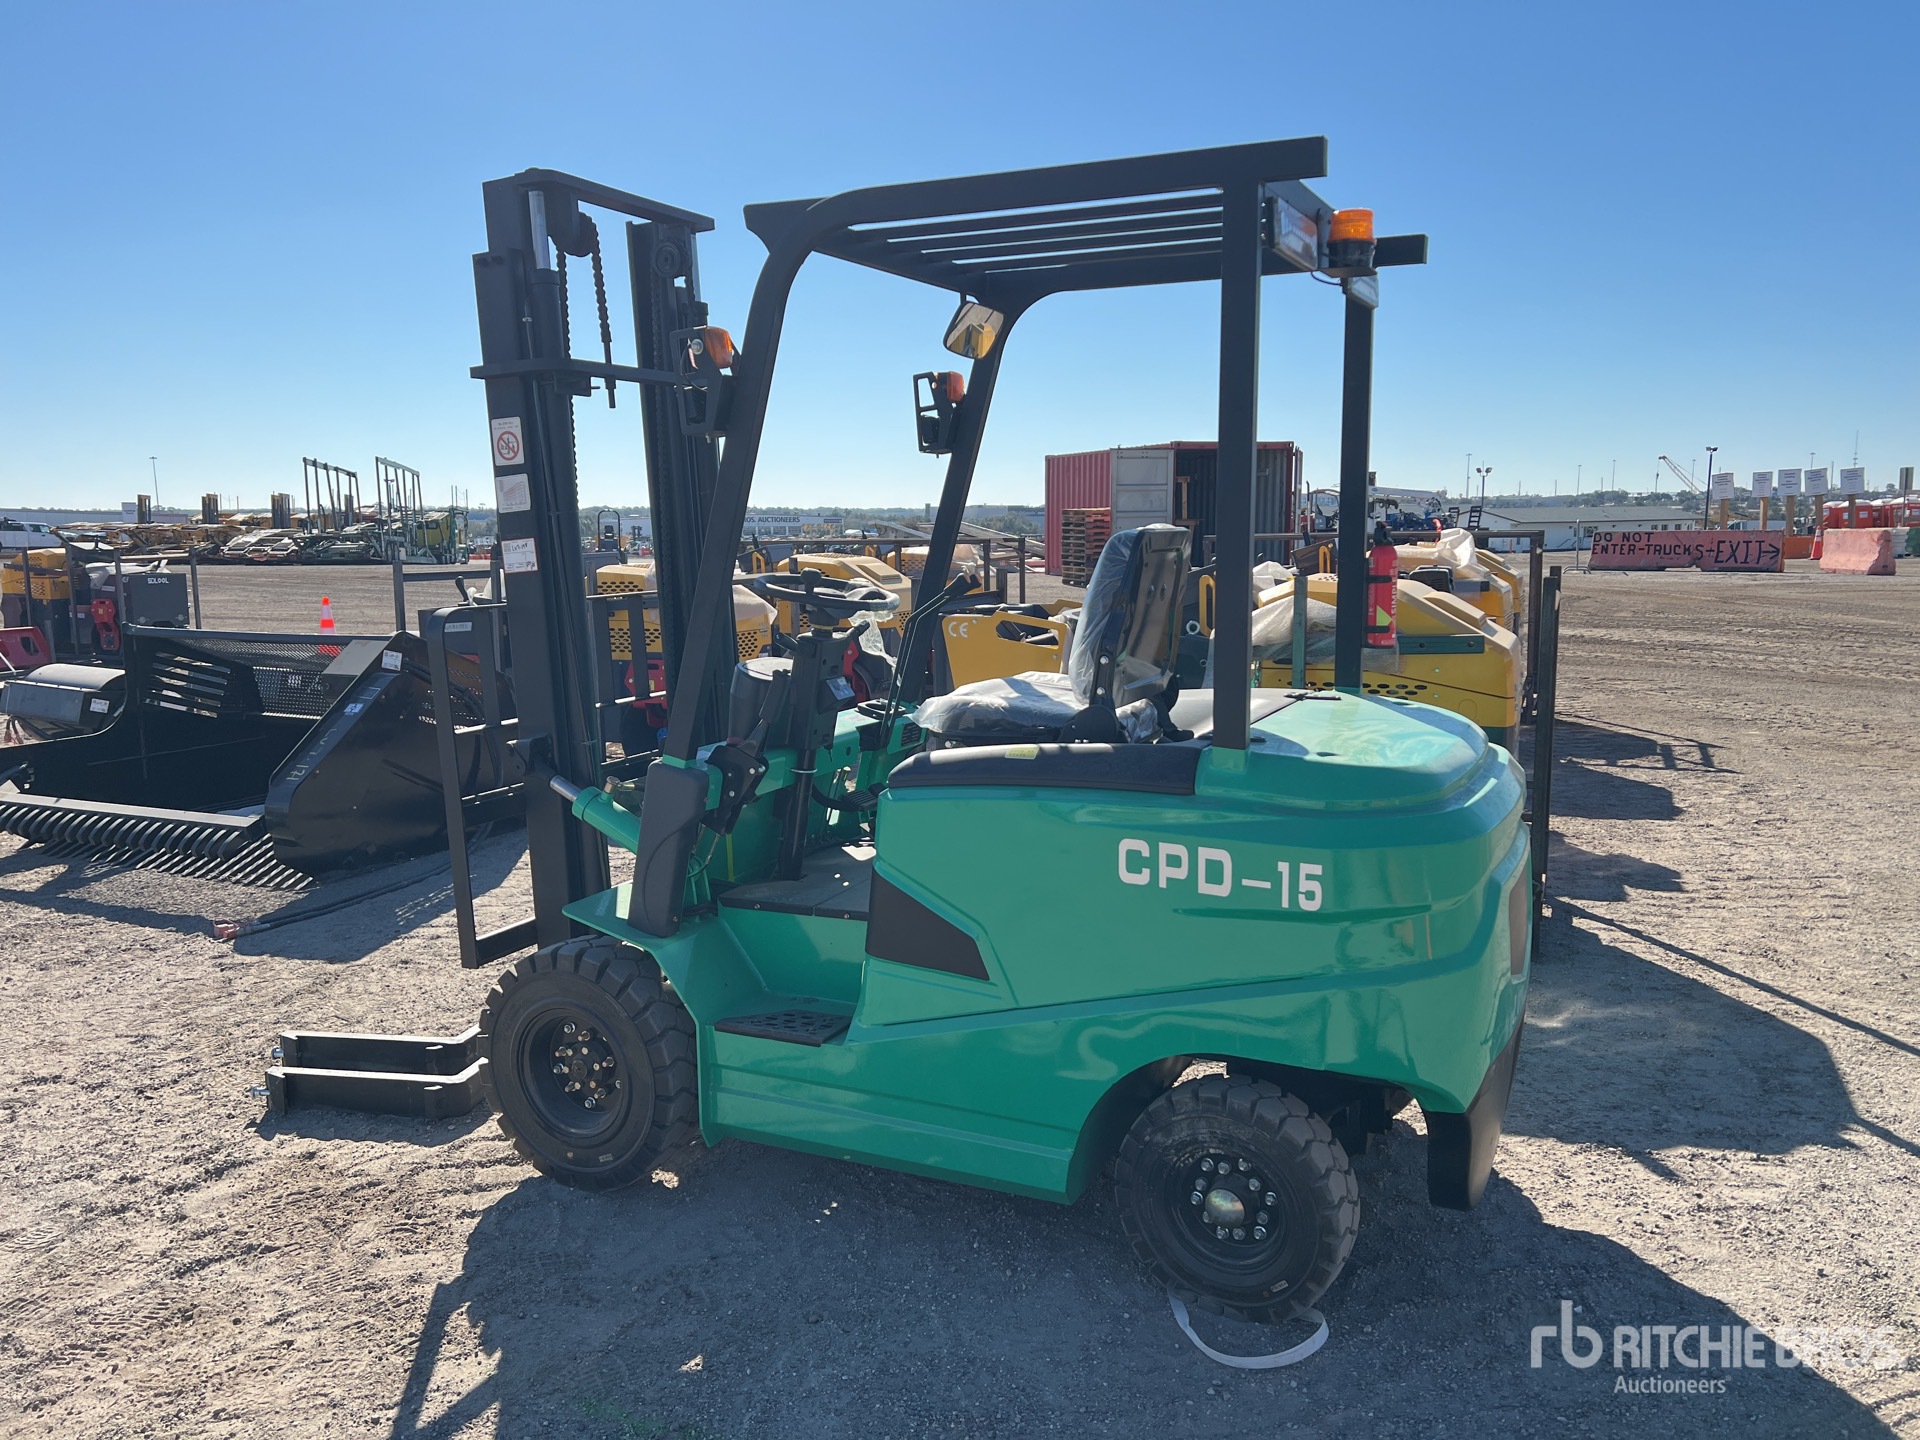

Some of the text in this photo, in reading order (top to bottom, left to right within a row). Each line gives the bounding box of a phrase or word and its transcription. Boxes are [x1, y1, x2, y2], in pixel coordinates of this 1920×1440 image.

[1593, 532, 1655, 543] DO NOT
[948, 621, 968, 638] CE
[1118, 838, 1323, 911] CPD-15
